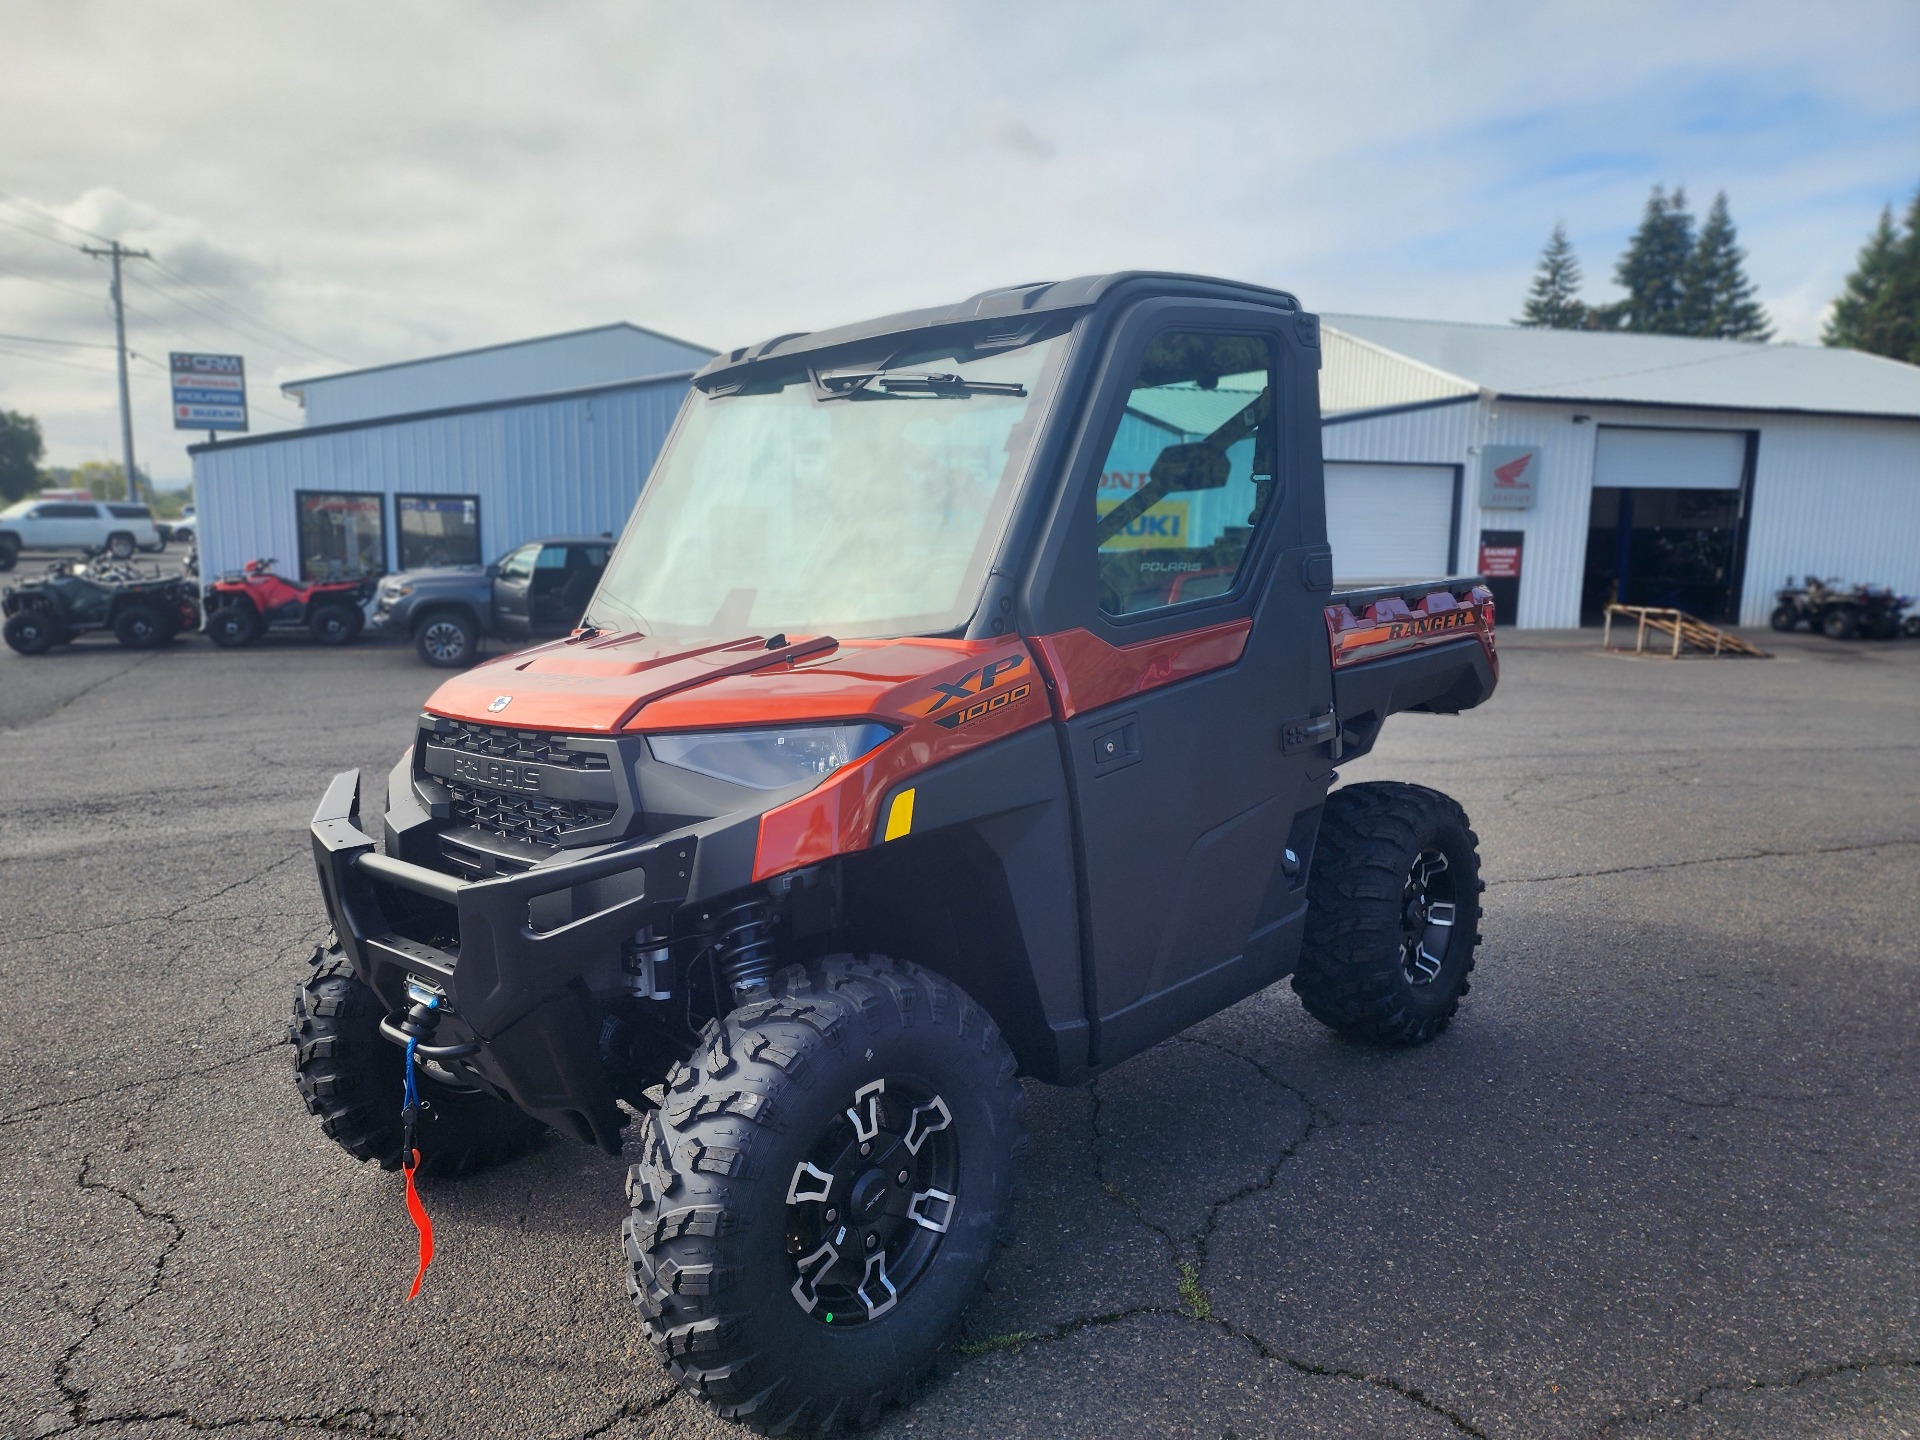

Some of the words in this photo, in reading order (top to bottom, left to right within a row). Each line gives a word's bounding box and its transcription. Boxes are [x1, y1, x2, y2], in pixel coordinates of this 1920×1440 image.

[176, 391, 240, 403] POLARIS
[192, 407, 242, 417] SUZUKI
[1140, 562, 1202, 572] POLARIS
[1389, 611, 1467, 640] RANGER
[924, 654, 1025, 715] XP
[958, 683, 1030, 724] 1000
[453, 755, 541, 791] POLARIS
